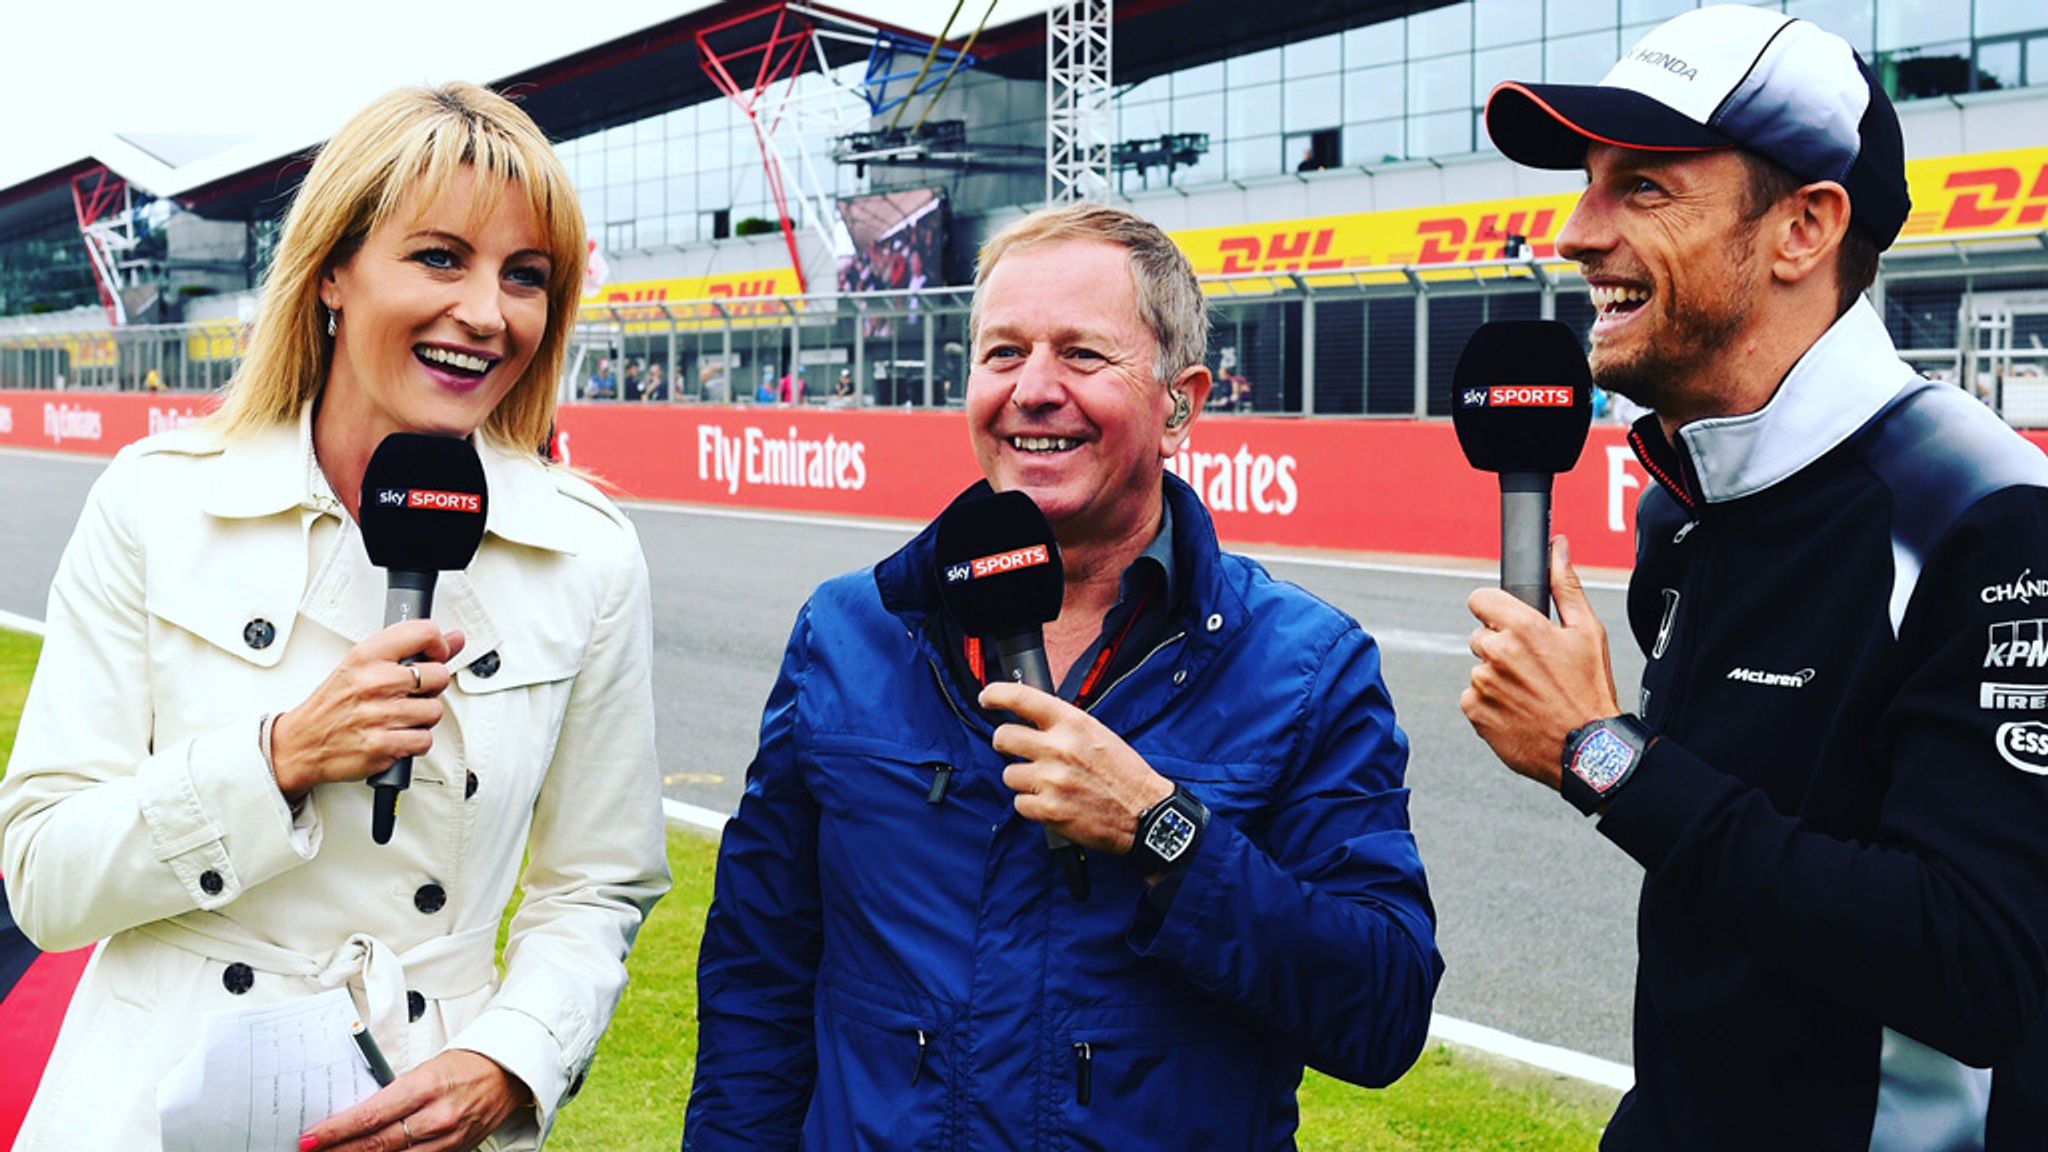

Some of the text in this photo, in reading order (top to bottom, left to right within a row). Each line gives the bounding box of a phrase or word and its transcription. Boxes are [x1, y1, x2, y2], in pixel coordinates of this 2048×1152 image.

[1635, 48, 1698, 81] HONDA
[1218, 229, 1344, 274] DHL
[1415, 208, 1557, 264] DHL
[607, 289, 668, 318] DHL
[706, 279, 776, 316] DHL
[1463, 389, 1569, 406] sky SPORTS
[697, 424, 866, 495] Fly Emirates
[1164, 436, 1298, 515] irates
[379, 489, 478, 510] sky SPORTS
[947, 549, 1045, 581] sky SPORTS
[1726, 668, 1803, 688] McLaren
